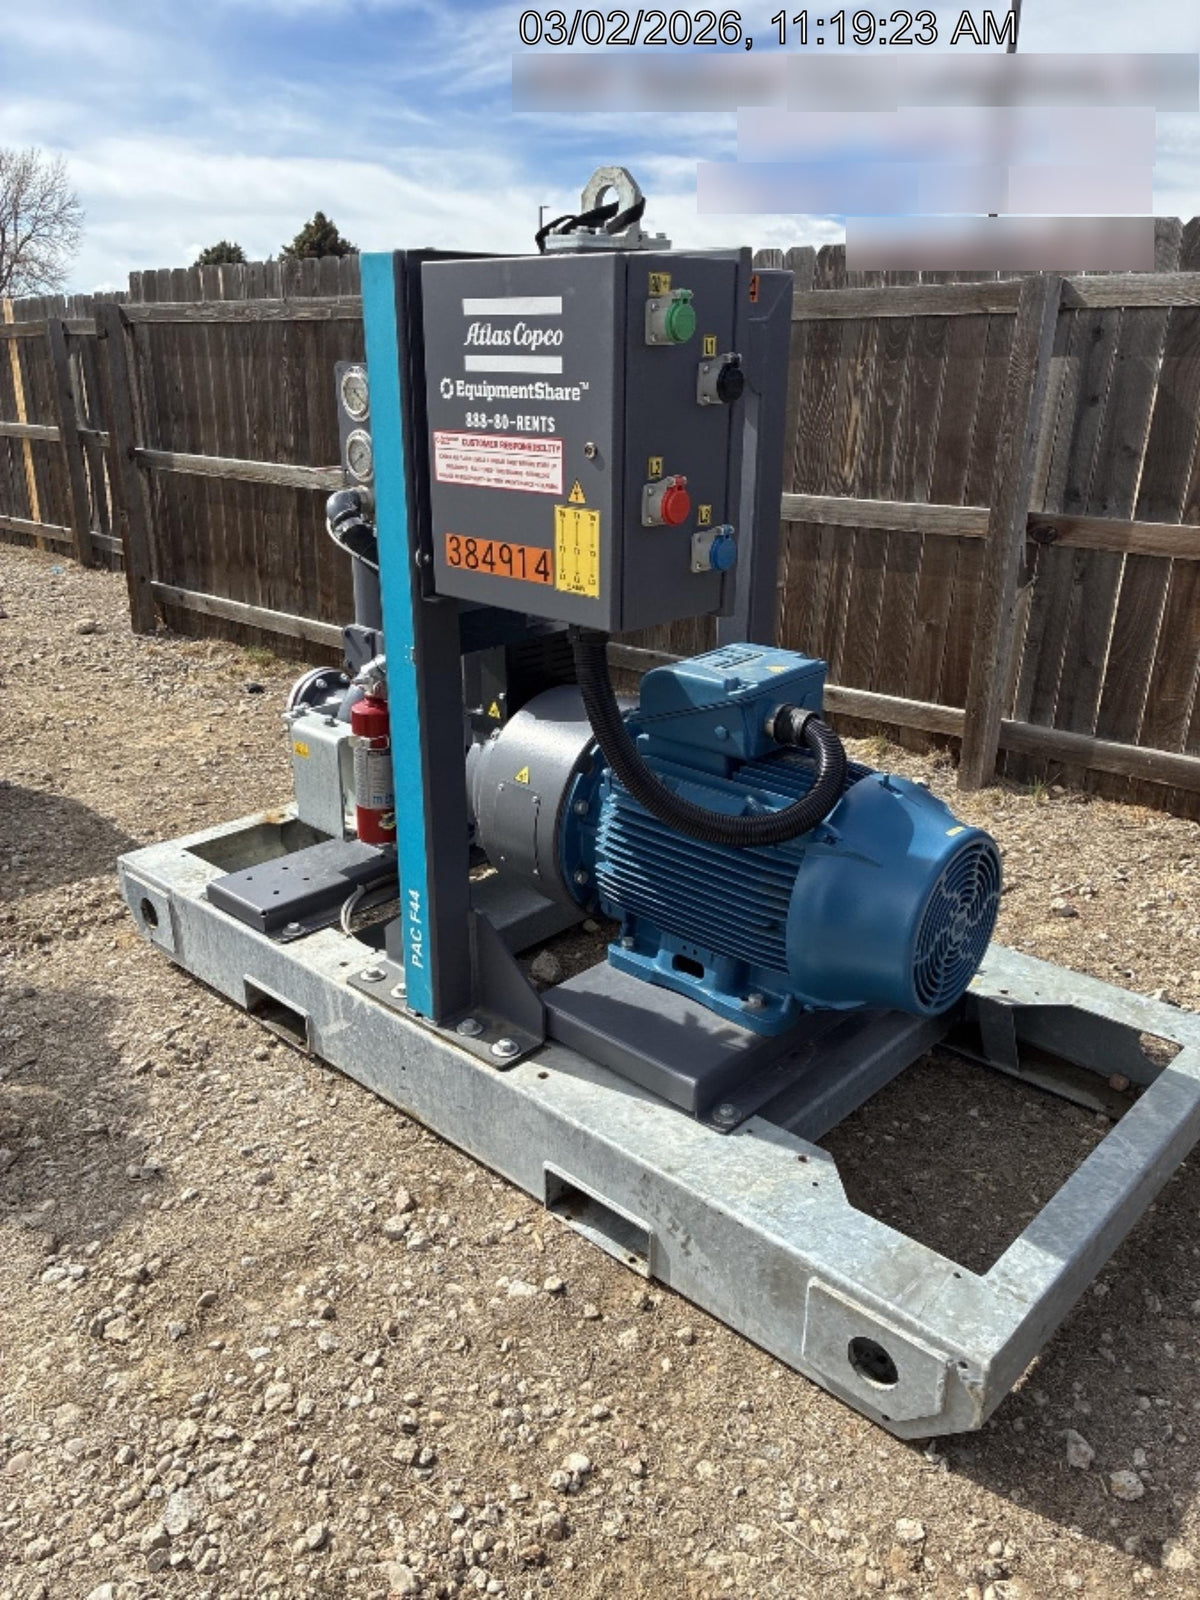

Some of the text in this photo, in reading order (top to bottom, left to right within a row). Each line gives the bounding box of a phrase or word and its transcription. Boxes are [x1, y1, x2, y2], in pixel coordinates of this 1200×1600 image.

[464, 321, 563, 351] Atlas Copco
[465, 411, 556, 433] 888-80-RENTS
[449, 536, 550, 582] 384914
[409, 889, 423, 969] PAC F44
